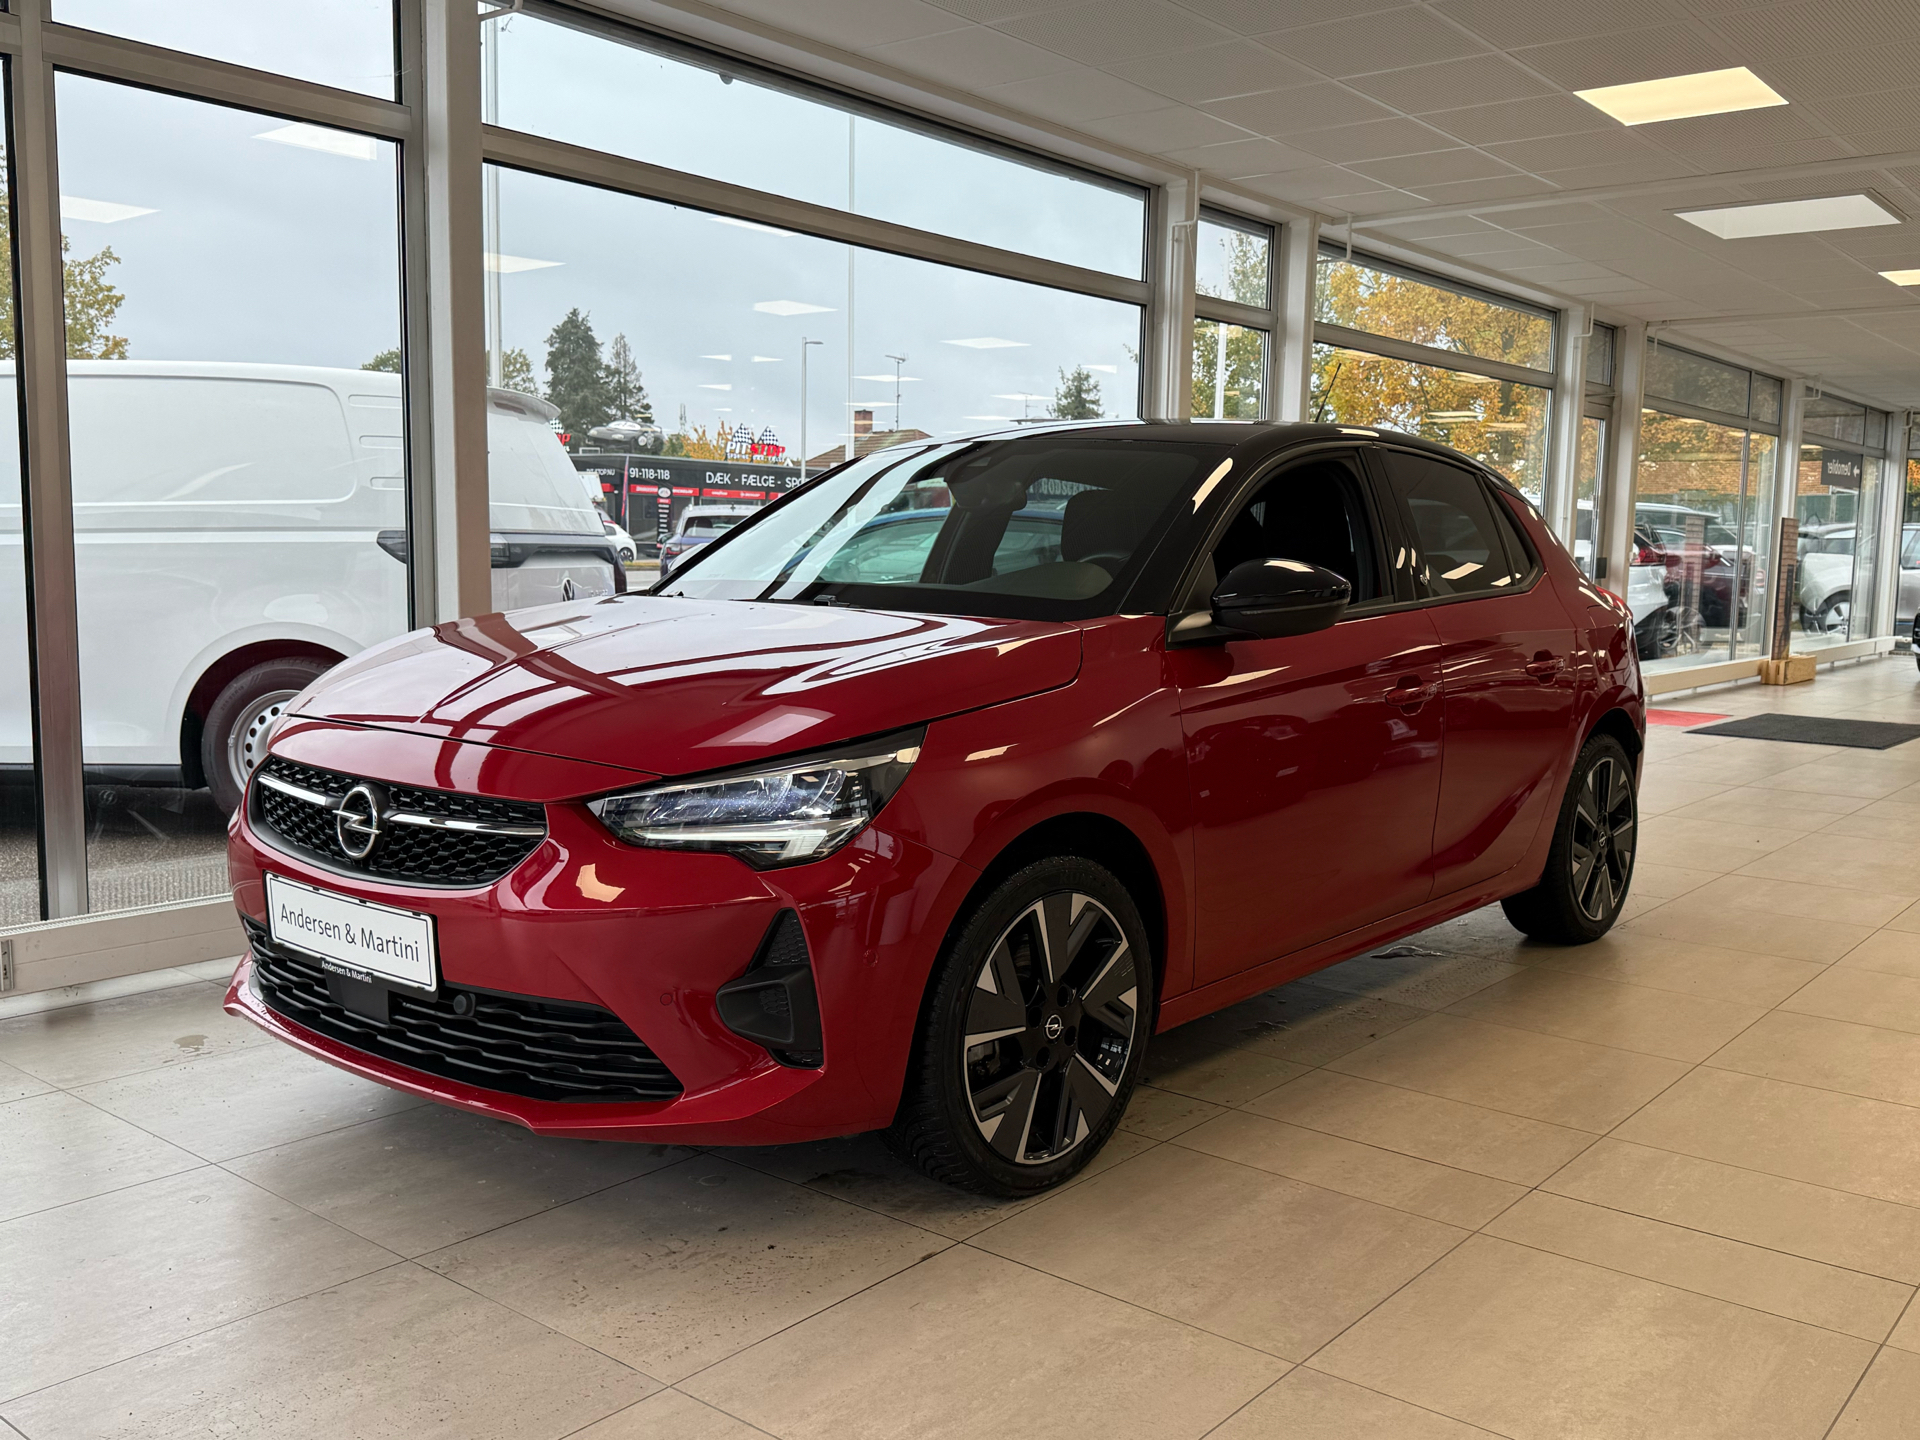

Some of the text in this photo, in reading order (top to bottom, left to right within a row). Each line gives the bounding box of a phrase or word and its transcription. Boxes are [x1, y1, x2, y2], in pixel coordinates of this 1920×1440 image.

[726, 441, 786, 457] PIT STOP
[629, 468, 670, 480] 91-118-118
[705, 472, 731, 485] DÆK
[741, 474, 775, 487] FÆLGE
[281, 903, 420, 963] Andersen & Martini
[321, 960, 373, 984] Andersen & Martini
